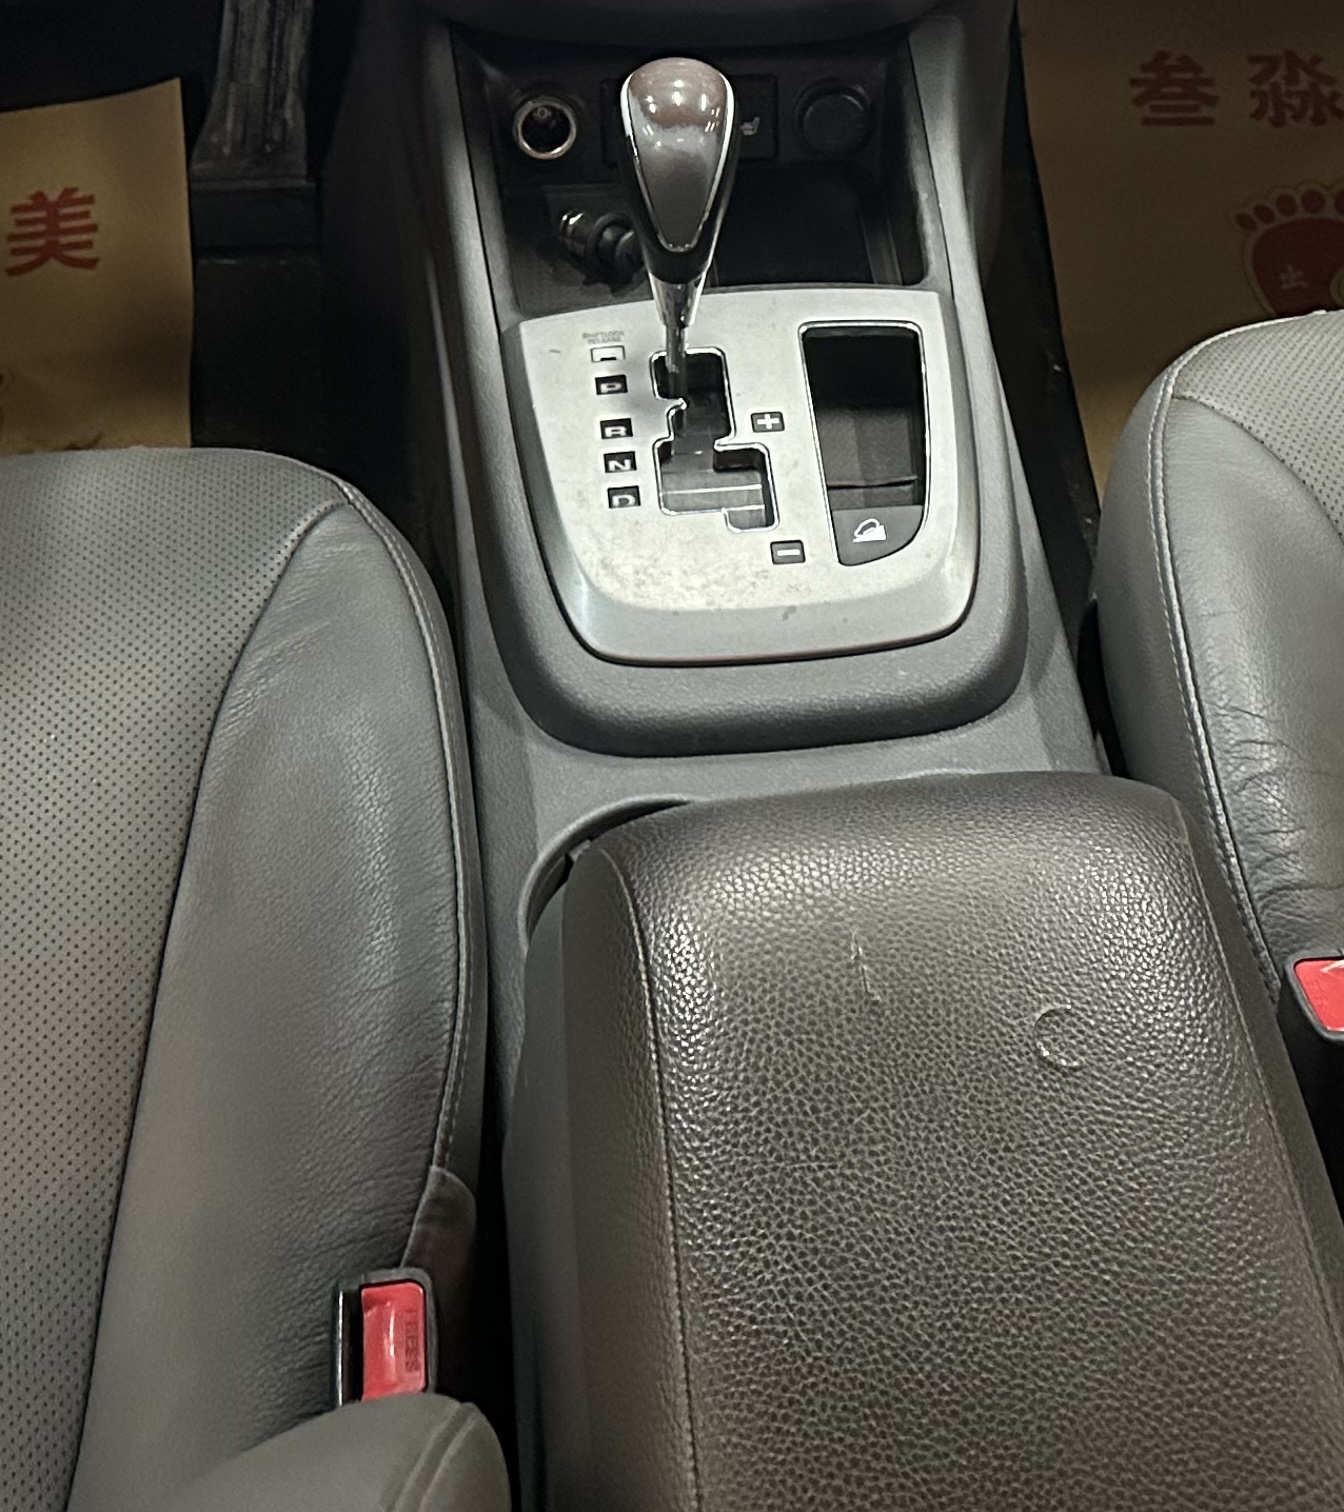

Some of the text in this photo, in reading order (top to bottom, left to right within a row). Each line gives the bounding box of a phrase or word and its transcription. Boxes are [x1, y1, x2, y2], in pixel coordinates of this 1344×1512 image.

[600, 382, 622, 394] P
[605, 426, 628, 438] R
[608, 460, 632, 471] N
[612, 494, 636, 506] D
